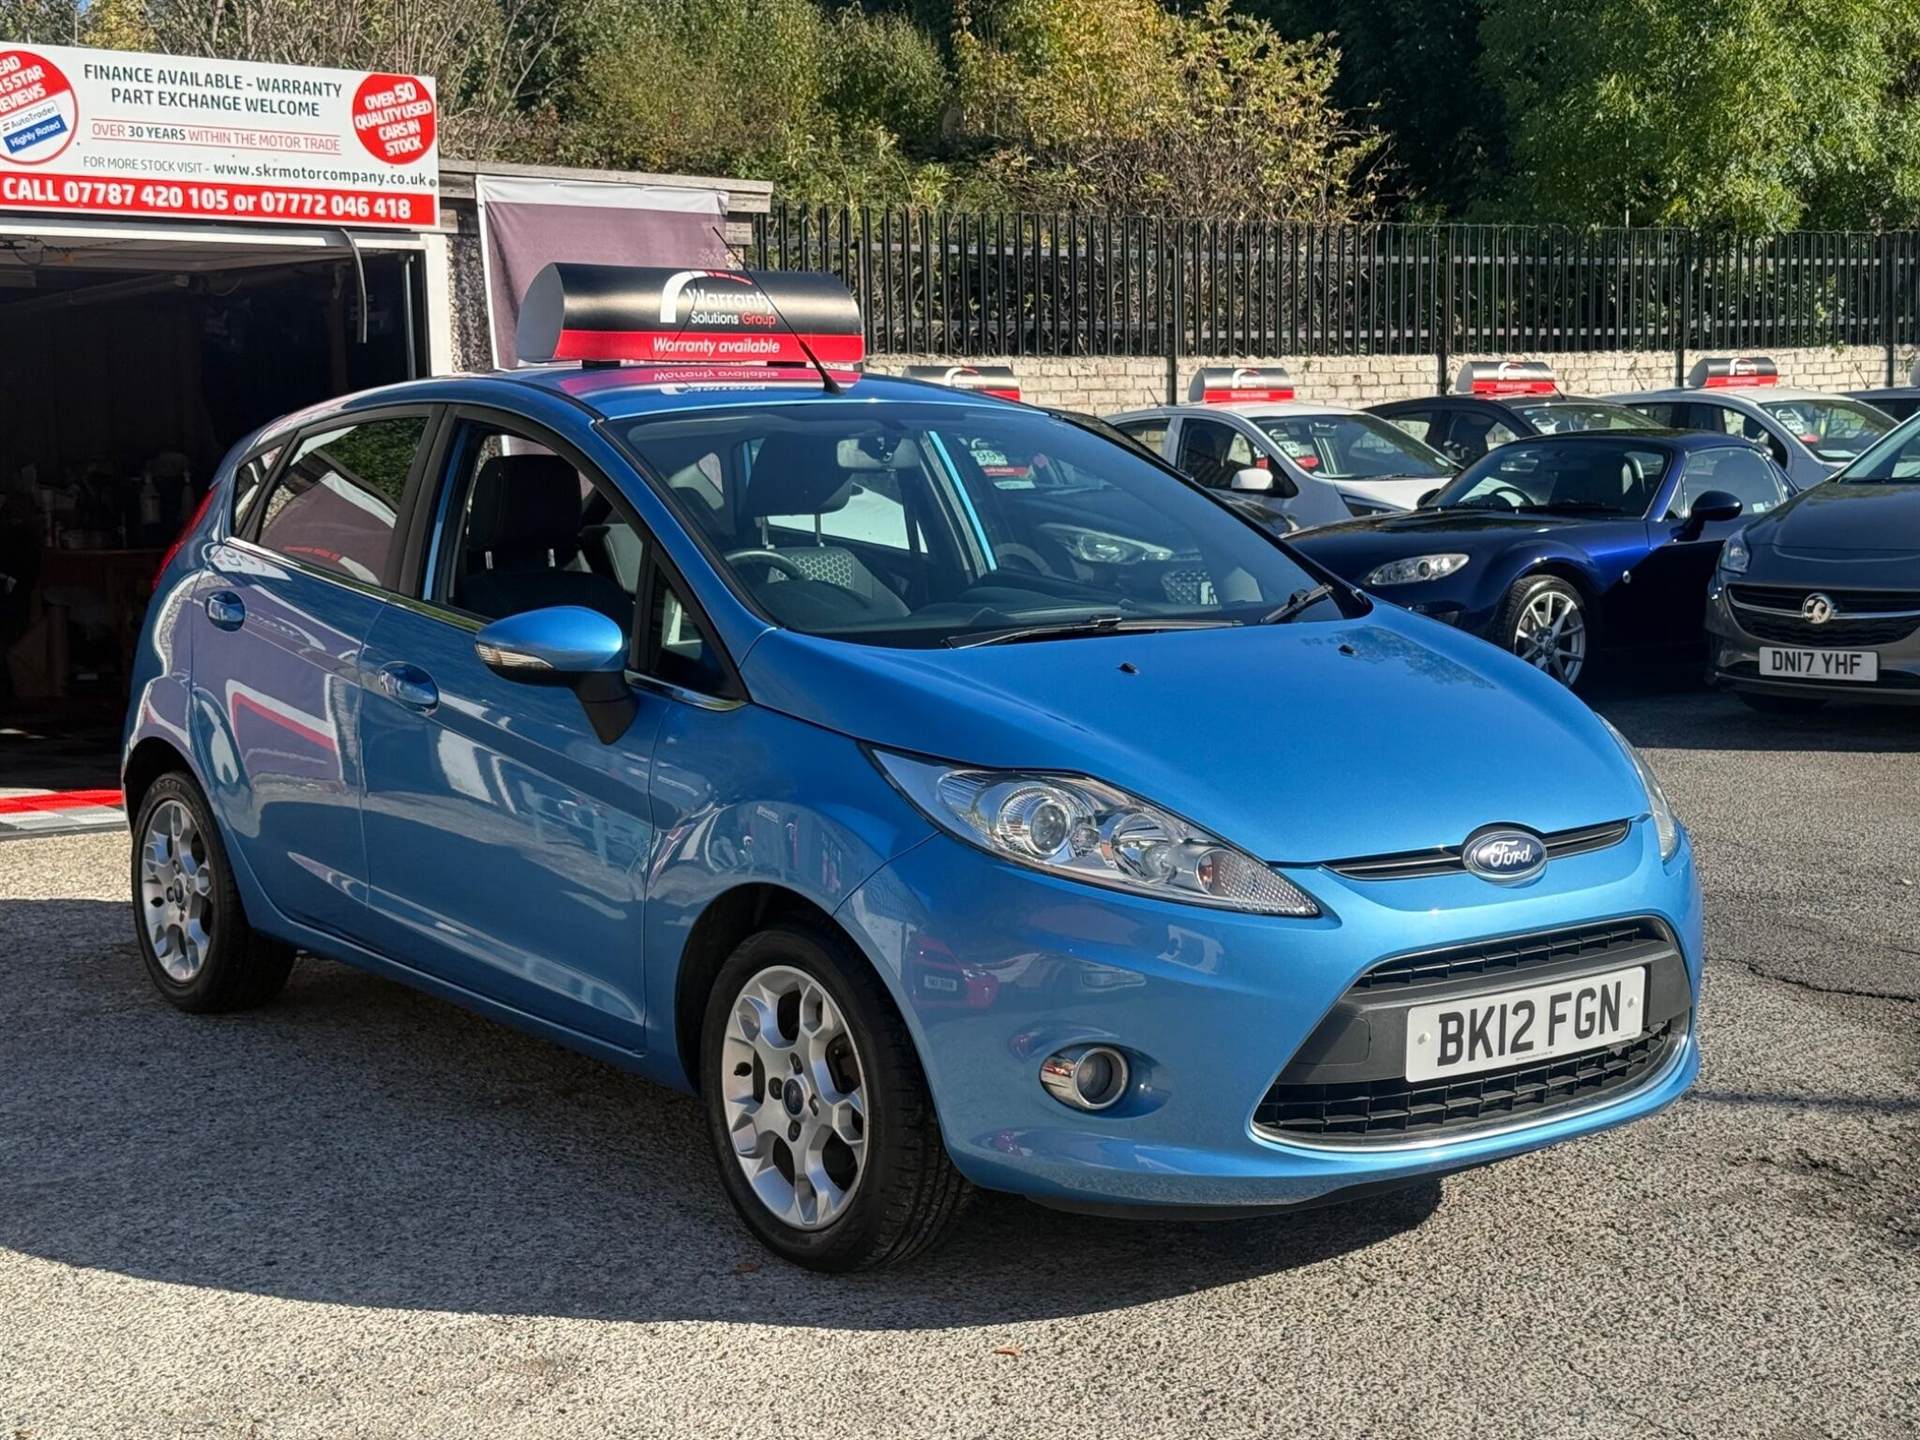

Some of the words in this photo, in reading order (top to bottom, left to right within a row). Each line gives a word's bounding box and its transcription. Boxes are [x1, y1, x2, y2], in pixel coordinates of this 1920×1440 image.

[10, 65, 45, 88] STAR
[84, 64, 154, 83] FINANCE
[157, 69, 243, 90] AVAILABLE
[256, 77, 342, 98] WARRANTY
[111, 88, 154, 105] PART
[158, 91, 242, 112] EXCHANGE
[245, 97, 320, 117] WELCOME
[364, 91, 397, 110] OVER
[394, 82, 417, 104] 50
[11, 106, 56, 130] AutoTrader
[355, 106, 402, 131] QUALITY
[401, 100, 432, 119] USED
[9, 131, 36, 148] Highly
[35, 120, 61, 137] Rated
[92, 123, 126, 137] OVER
[128, 125, 144, 138] 30
[146, 127, 186, 141] YEARS
[188, 130, 231, 143] WITHIN
[234, 132, 257, 145] THE
[259, 134, 301, 148] MOTOR
[303, 136, 340, 151] TRADE
[378, 122, 408, 141] CARS
[406, 119, 421, 135] IN
[384, 136, 423, 157] STOCK
[83, 156, 106, 168] FOR
[107, 158, 138, 170] MORE
[140, 159, 175, 172] STOCK
[176, 162, 202, 173] VISIT
[213, 163, 427, 187] www.skrmotorcompany.co.uk
[3, 177, 60, 202] CALL
[63, 181, 135, 205] 07787
[140, 185, 184, 208] 420
[188, 188, 229, 210] 105
[234, 194, 257, 212] or
[260, 191, 327, 215] 07772
[331, 195, 370, 218] 046
[373, 198, 412, 220] 418
[685, 288, 773, 314] Warranty
[690, 311, 739, 325] Solutions
[741, 312, 776, 328] Group
[653, 337, 716, 357] Warranty
[718, 338, 781, 354] available
[1771, 651, 1815, 673] DN17
[1821, 652, 1862, 675] YHF
[1490, 840, 1532, 868] Ford
[1437, 1000, 1536, 1067] BK12
[1548, 980, 1622, 1047] FGN
